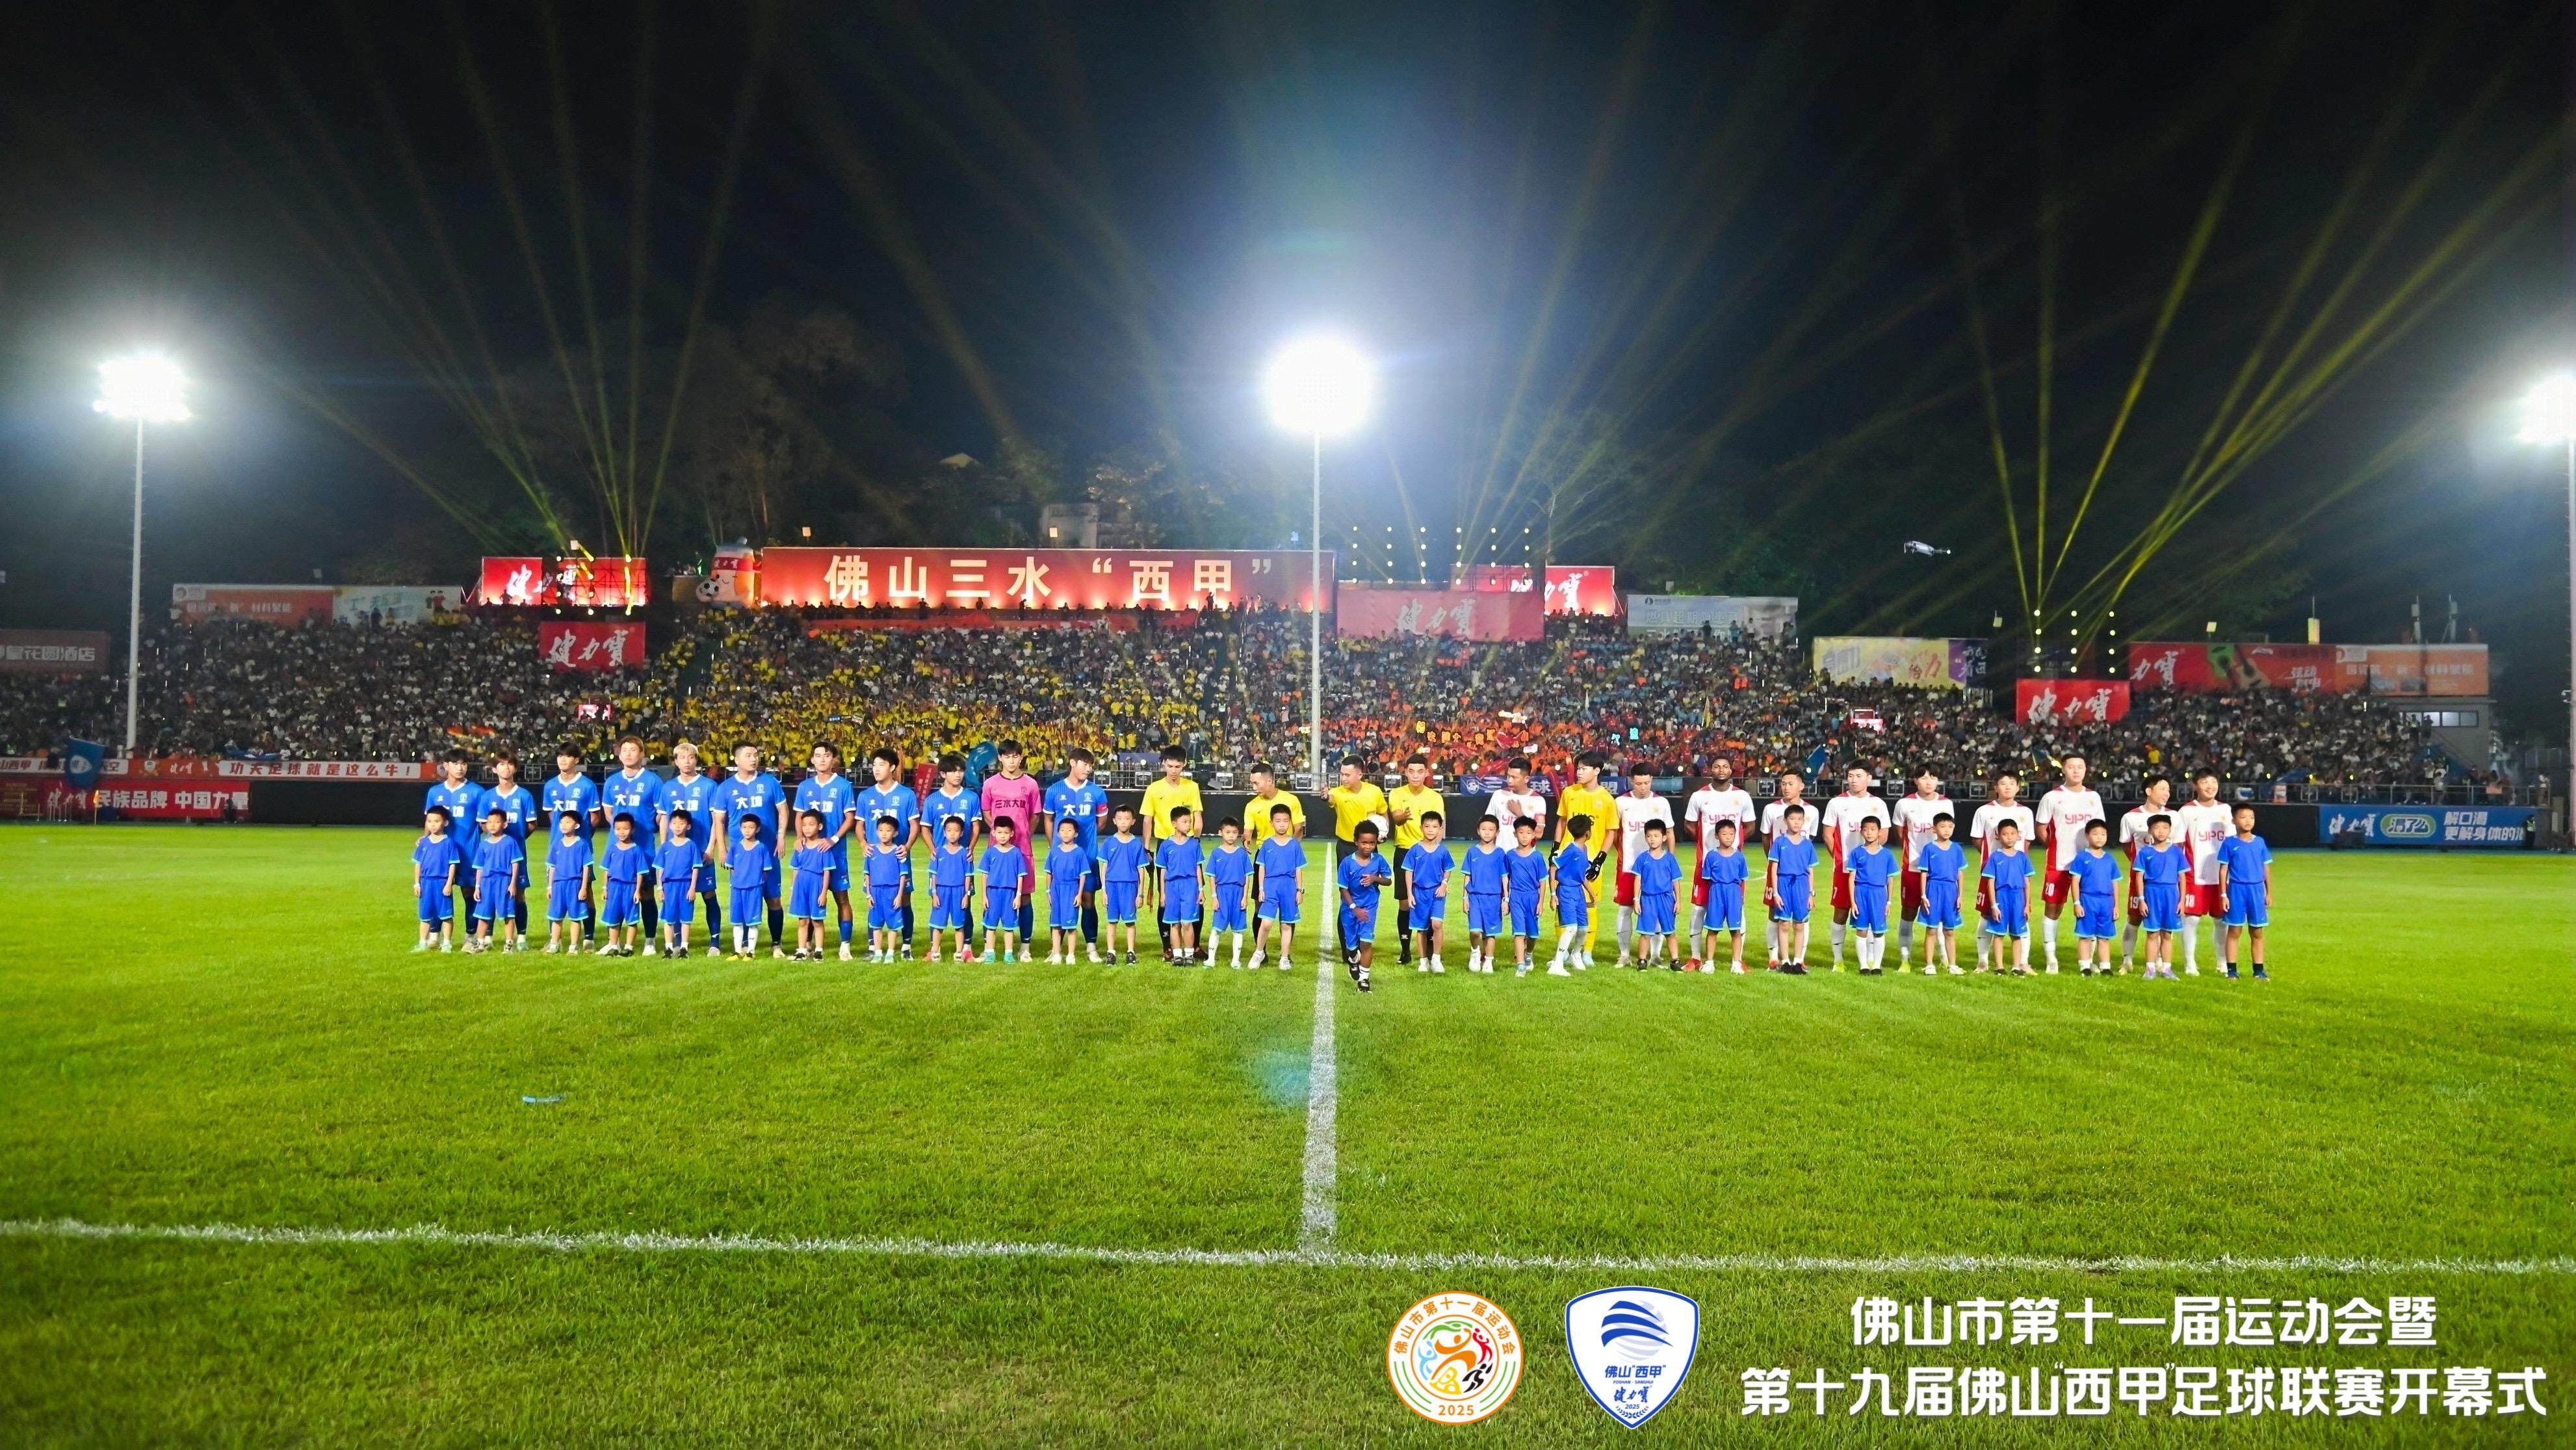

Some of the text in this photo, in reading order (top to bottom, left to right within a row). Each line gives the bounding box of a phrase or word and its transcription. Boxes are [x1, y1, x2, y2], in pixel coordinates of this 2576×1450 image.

[824, 555, 1272, 601] 佛山三水“西甲”
[2199, 829, 2225, 841] YPG
